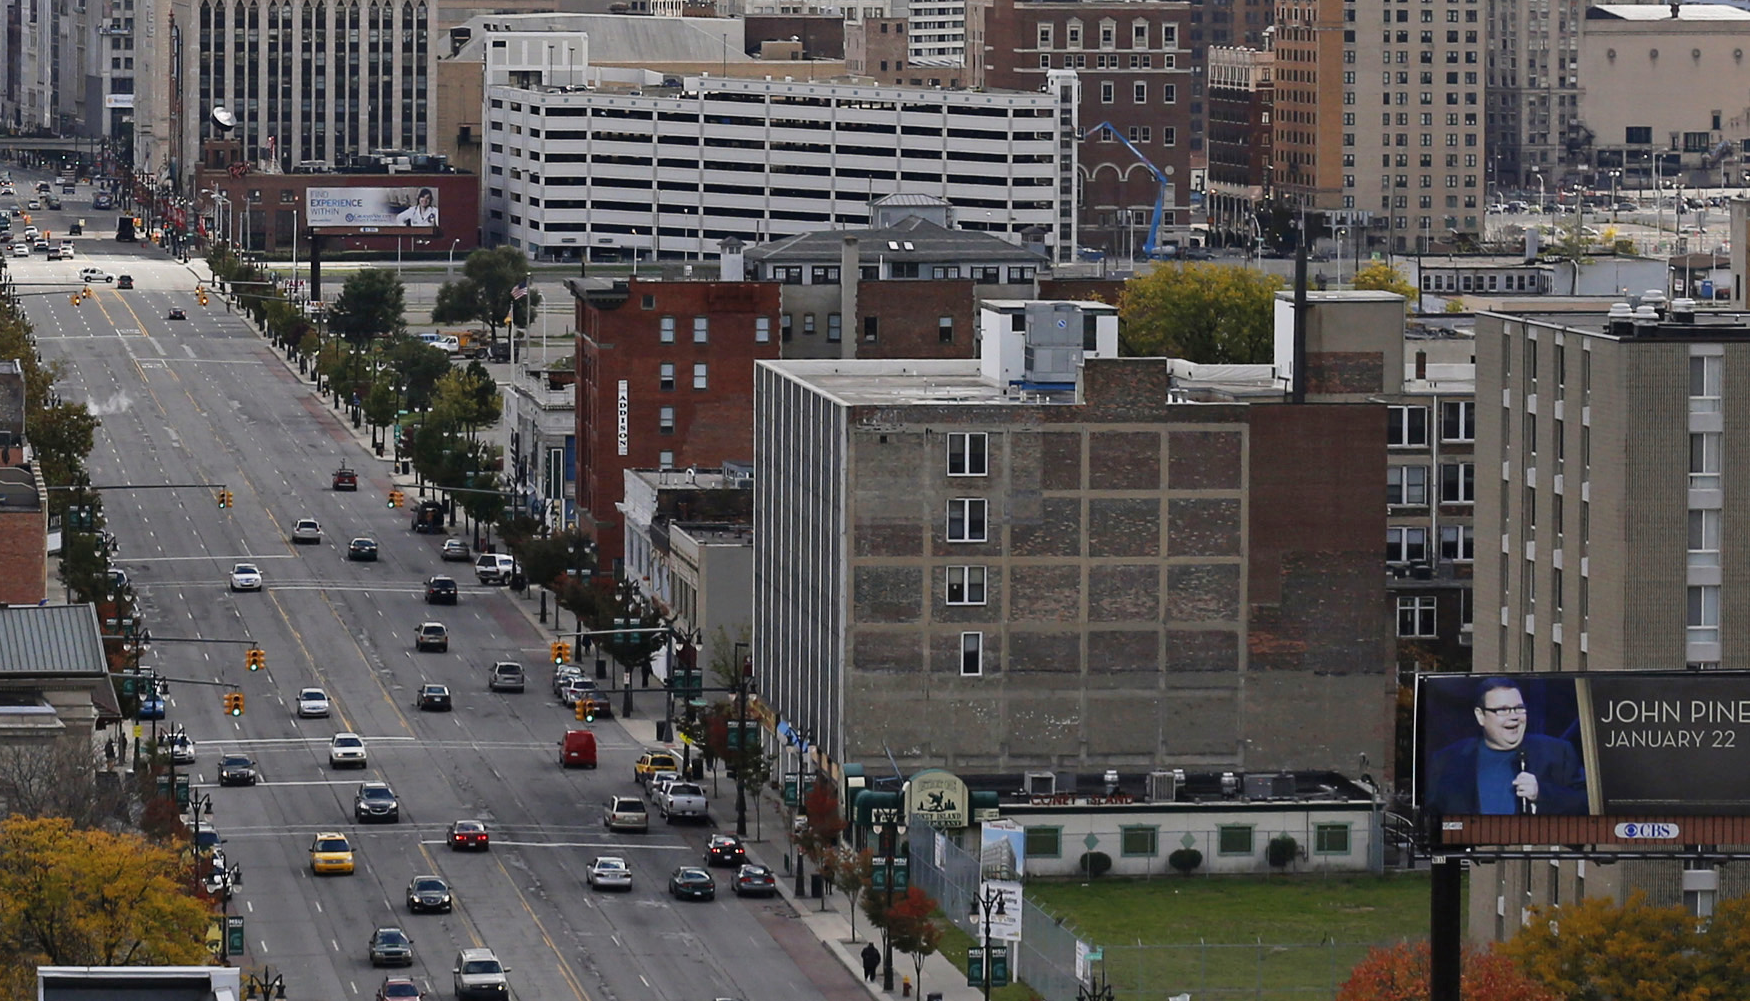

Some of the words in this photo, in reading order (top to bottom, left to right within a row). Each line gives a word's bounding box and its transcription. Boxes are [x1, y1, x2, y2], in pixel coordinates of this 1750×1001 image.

[310, 199, 363, 207] EXPERIENCE
[310, 208, 340, 216] WITHIN
[619, 395, 628, 447] ADDISON
[1601, 700, 1680, 723] JOHN
[1691, 700, 1750, 723] PINE
[1605, 730, 1705, 748] JANUARY
[1711, 730, 1736, 748] 22
[1086, 794, 1135, 805] ISLAND
[1640, 824, 1670, 837] CBS
